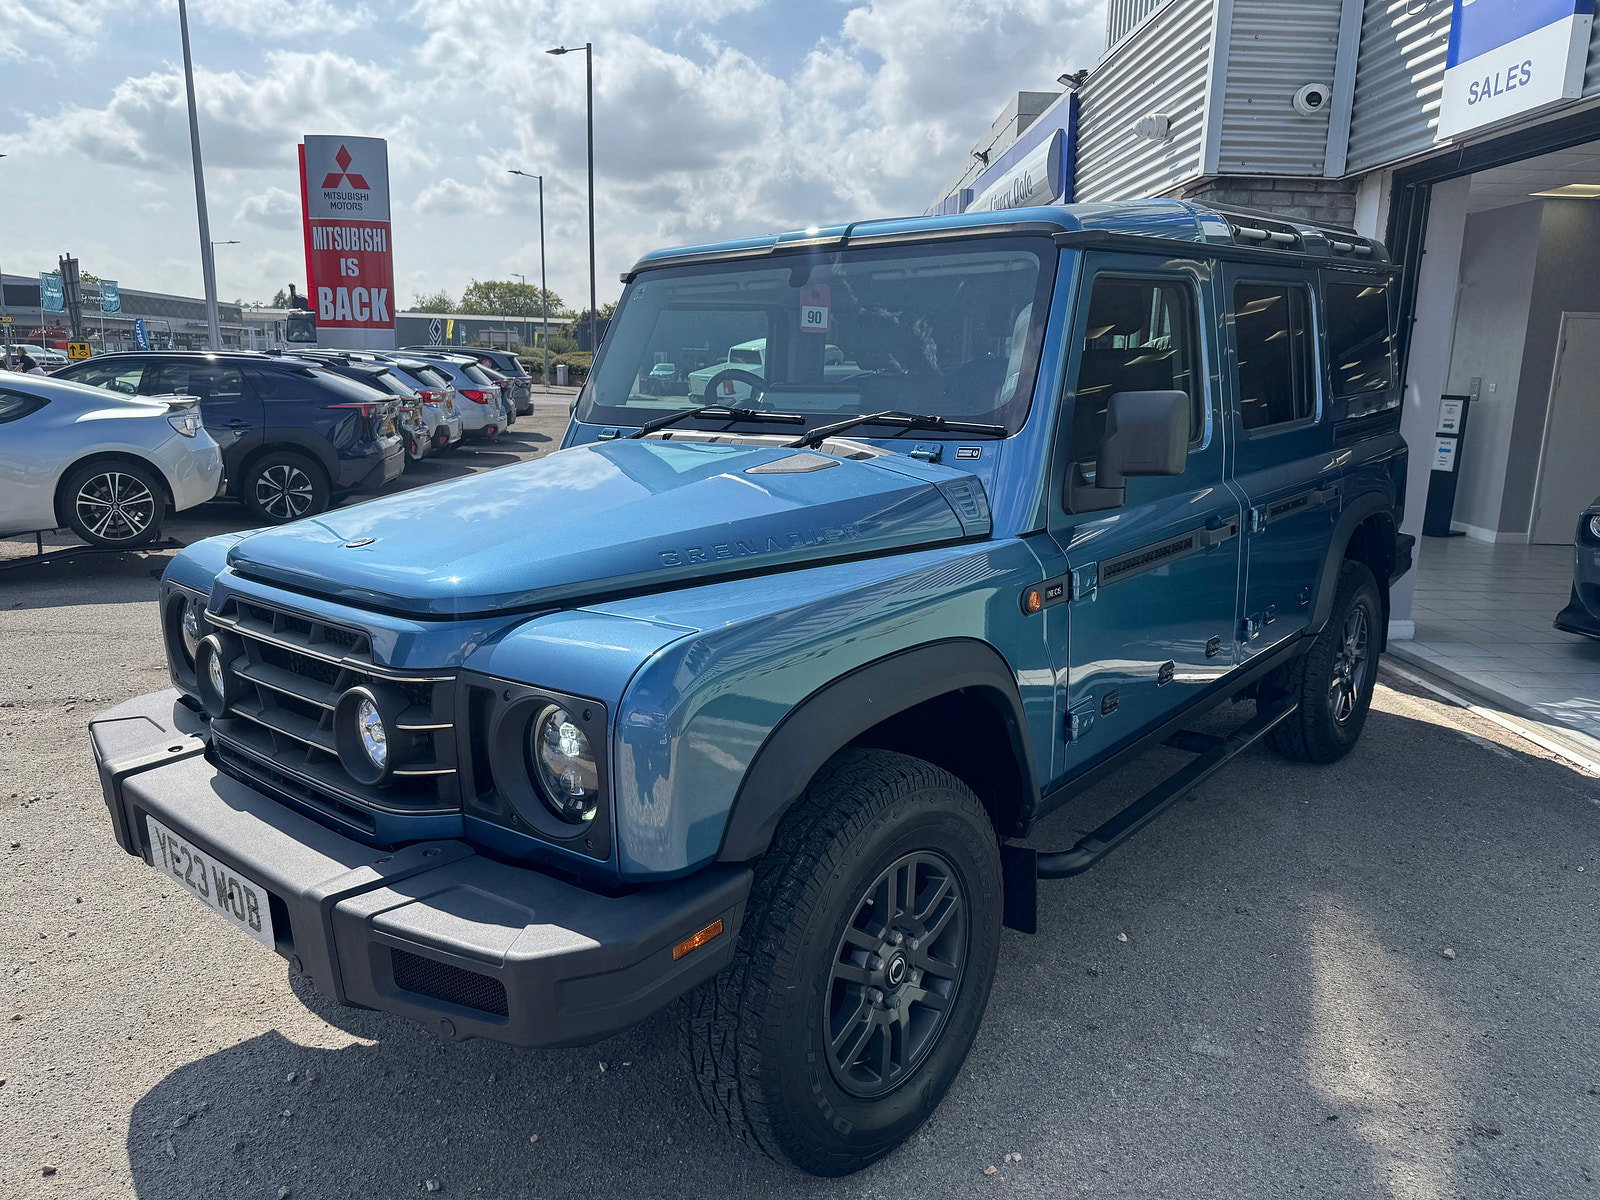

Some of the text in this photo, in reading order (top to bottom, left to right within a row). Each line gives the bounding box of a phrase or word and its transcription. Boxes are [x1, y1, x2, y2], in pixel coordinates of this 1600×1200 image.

[1467, 59, 1532, 105] SALES
[323, 191, 369, 201] MITSUBISHI
[1013, 170, 1033, 205] Dole
[330, 202, 363, 211] MOTORS
[312, 226, 387, 252] MITSUBISHI
[340, 257, 360, 277] IS
[317, 286, 390, 322] BACK
[807, 310, 822, 324] 90
[657, 523, 863, 568] GRENADIER
[154, 826, 262, 933] YE23 WOB
